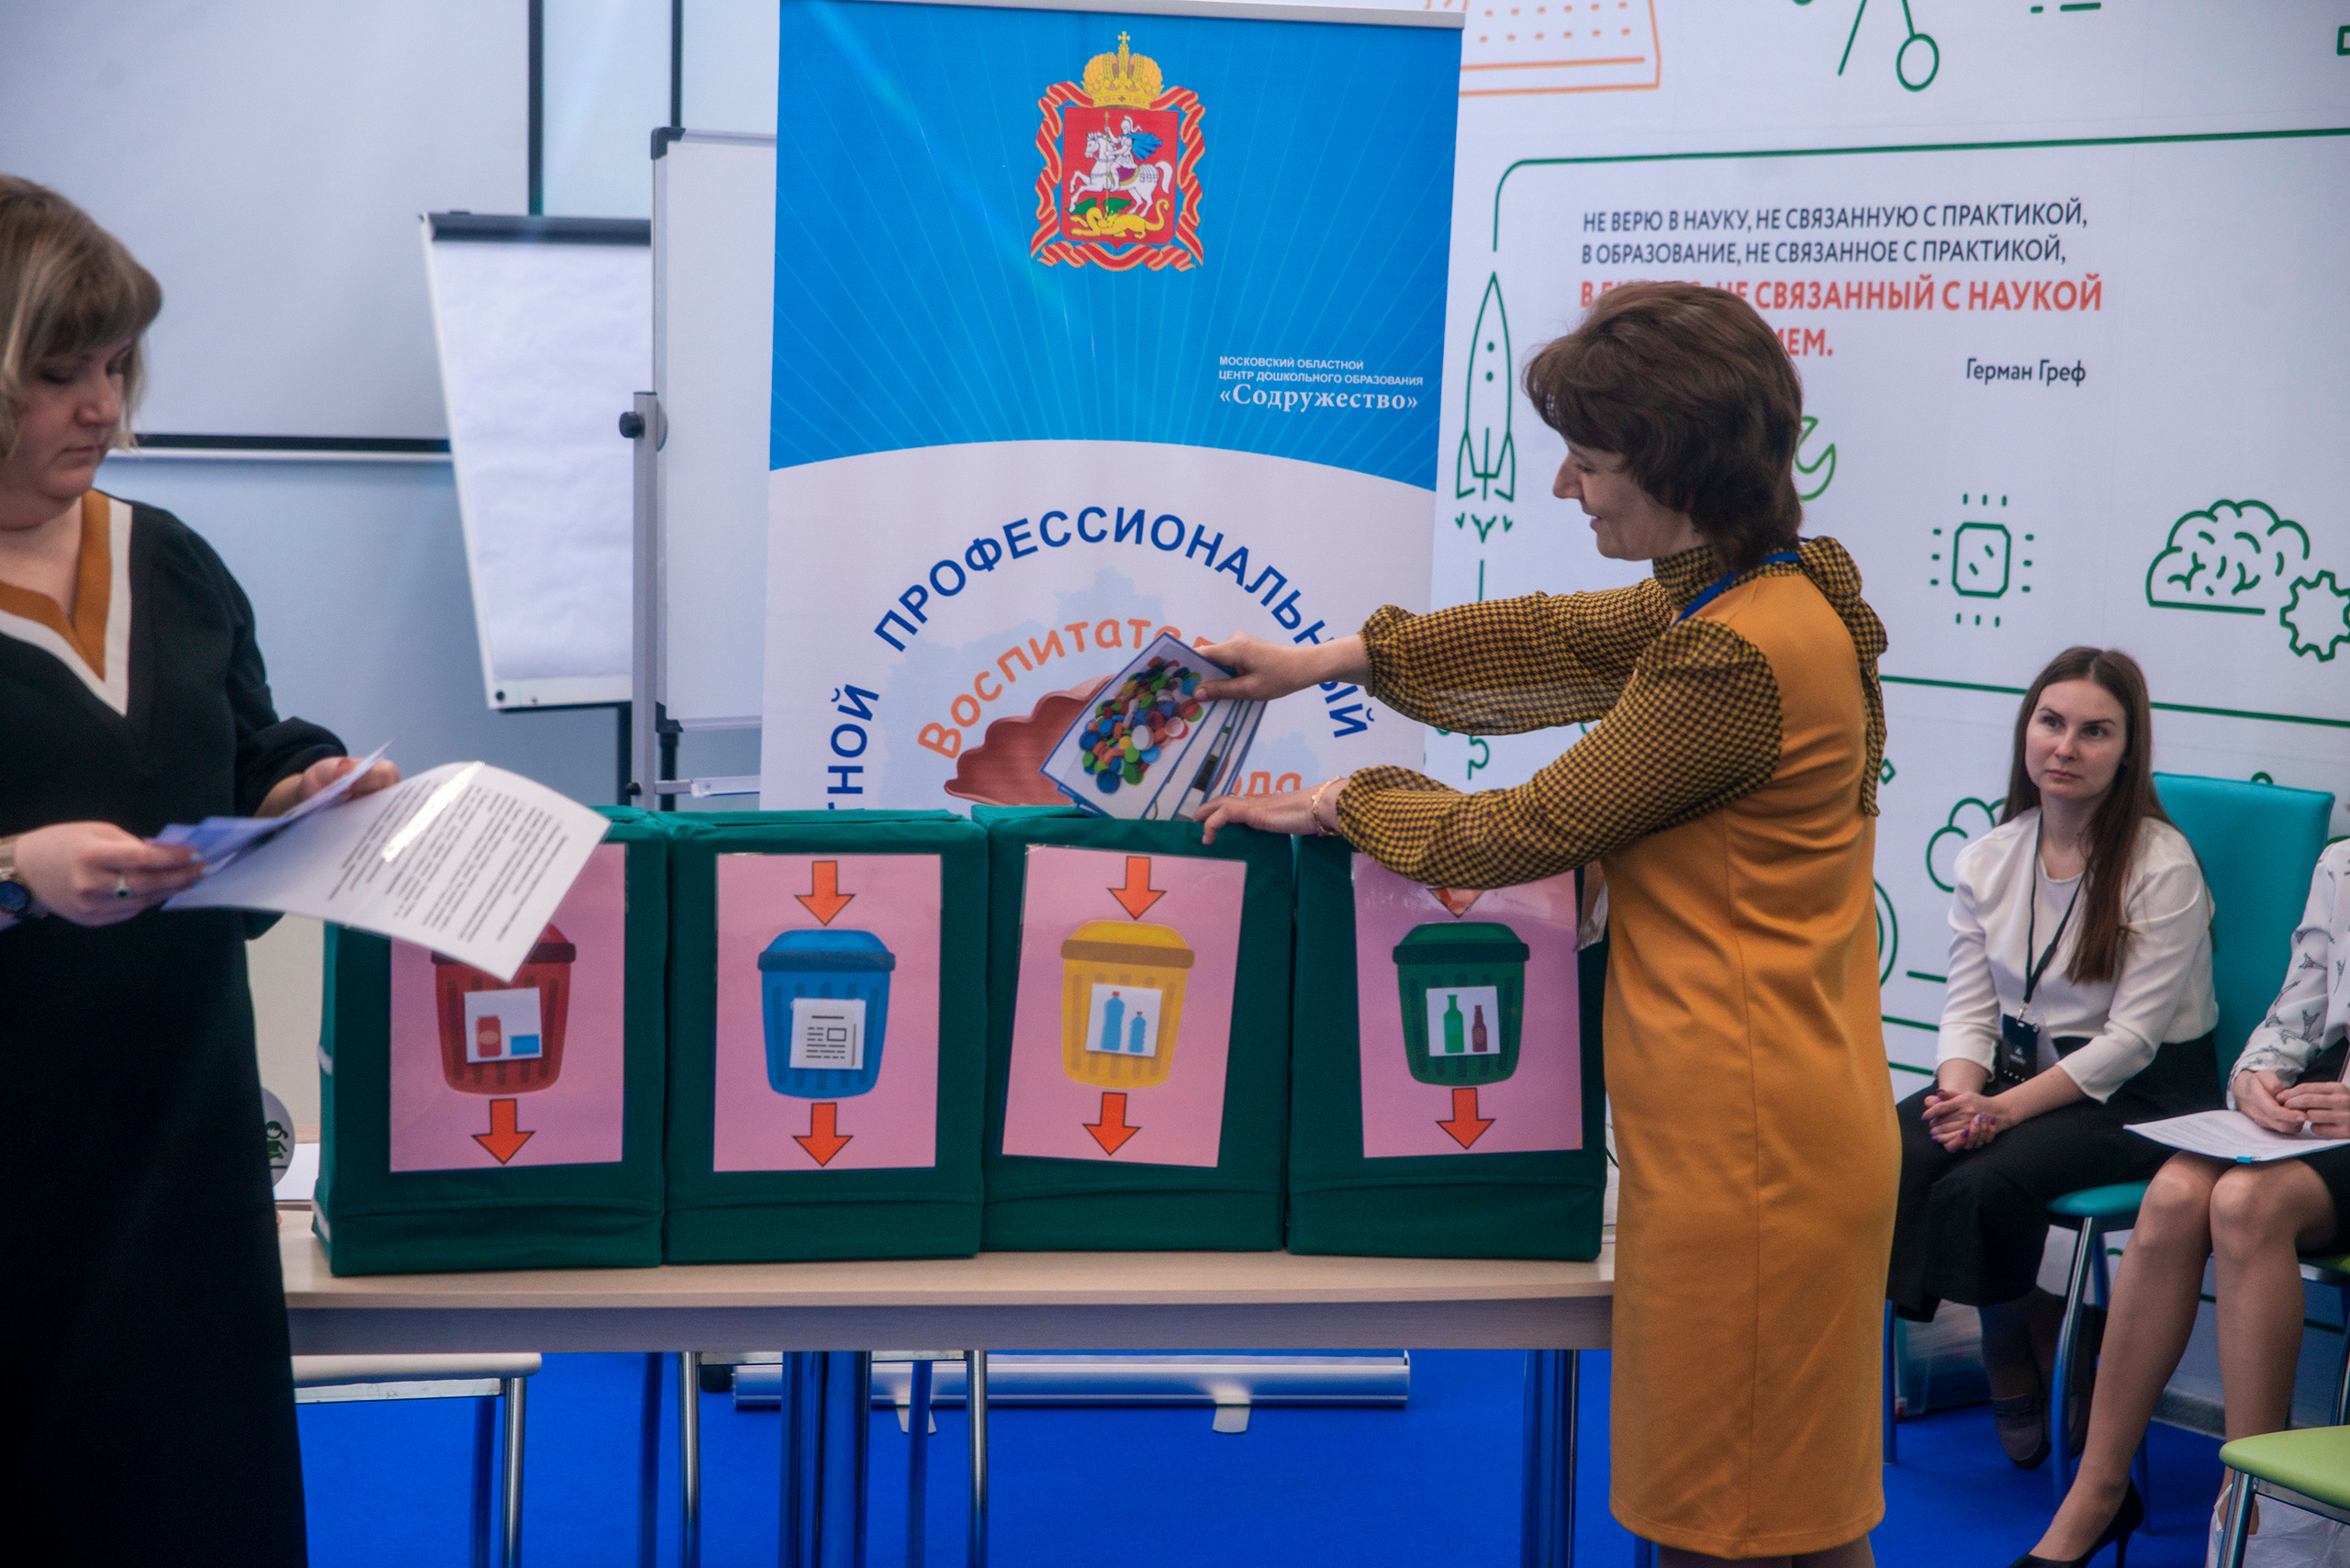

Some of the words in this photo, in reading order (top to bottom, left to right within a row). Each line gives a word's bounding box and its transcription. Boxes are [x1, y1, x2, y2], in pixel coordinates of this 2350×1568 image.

[1583, 212, 1606, 231] НЕ
[1611, 211, 1662, 231] ВЕРЮ
[1669, 210, 1679, 230] В
[1684, 209, 1751, 233] НАУКУ,
[1756, 208, 1780, 230] НЕ
[1785, 205, 1919, 229] СВЯЗАННУЮ
[1923, 205, 1937, 227] С
[1942, 197, 2087, 229] ПРАКТИКОЙ,
[1582, 243, 1592, 264] В
[1595, 242, 1741, 266] ОБРАЗОВАНИЕ,
[1746, 242, 1771, 263] НЕ
[1775, 241, 1898, 263] СВЯЗАННОЕ
[1904, 241, 1918, 262] С
[1922, 234, 2066, 264] ПРАКТИКОЙ,
[1581, 281, 1594, 308] В
[1754, 274, 1935, 310] СВЯЗАННЫЙ
[1942, 281, 1961, 310] С
[1968, 273, 2102, 311] НАУКОЙ
[1218, 370, 1254, 381] ЦЕНТР
[1256, 371, 1342, 384] ДОШКОЛЬНОГО
[1344, 374, 1424, 386] ОБРАЗОВАНИЯ
[1219, 355, 1294, 368] МОСКОВСКИЙ
[1297, 358, 1364, 370] ОБЛАСТНОЙ
[1966, 357, 2032, 386] Герман
[2039, 359, 2086, 387] Греф
[1219, 383, 1418, 413] «Содружество»
[917, 618, 1217, 759] Воспитат
[827, 683, 879, 810] НОЙ
